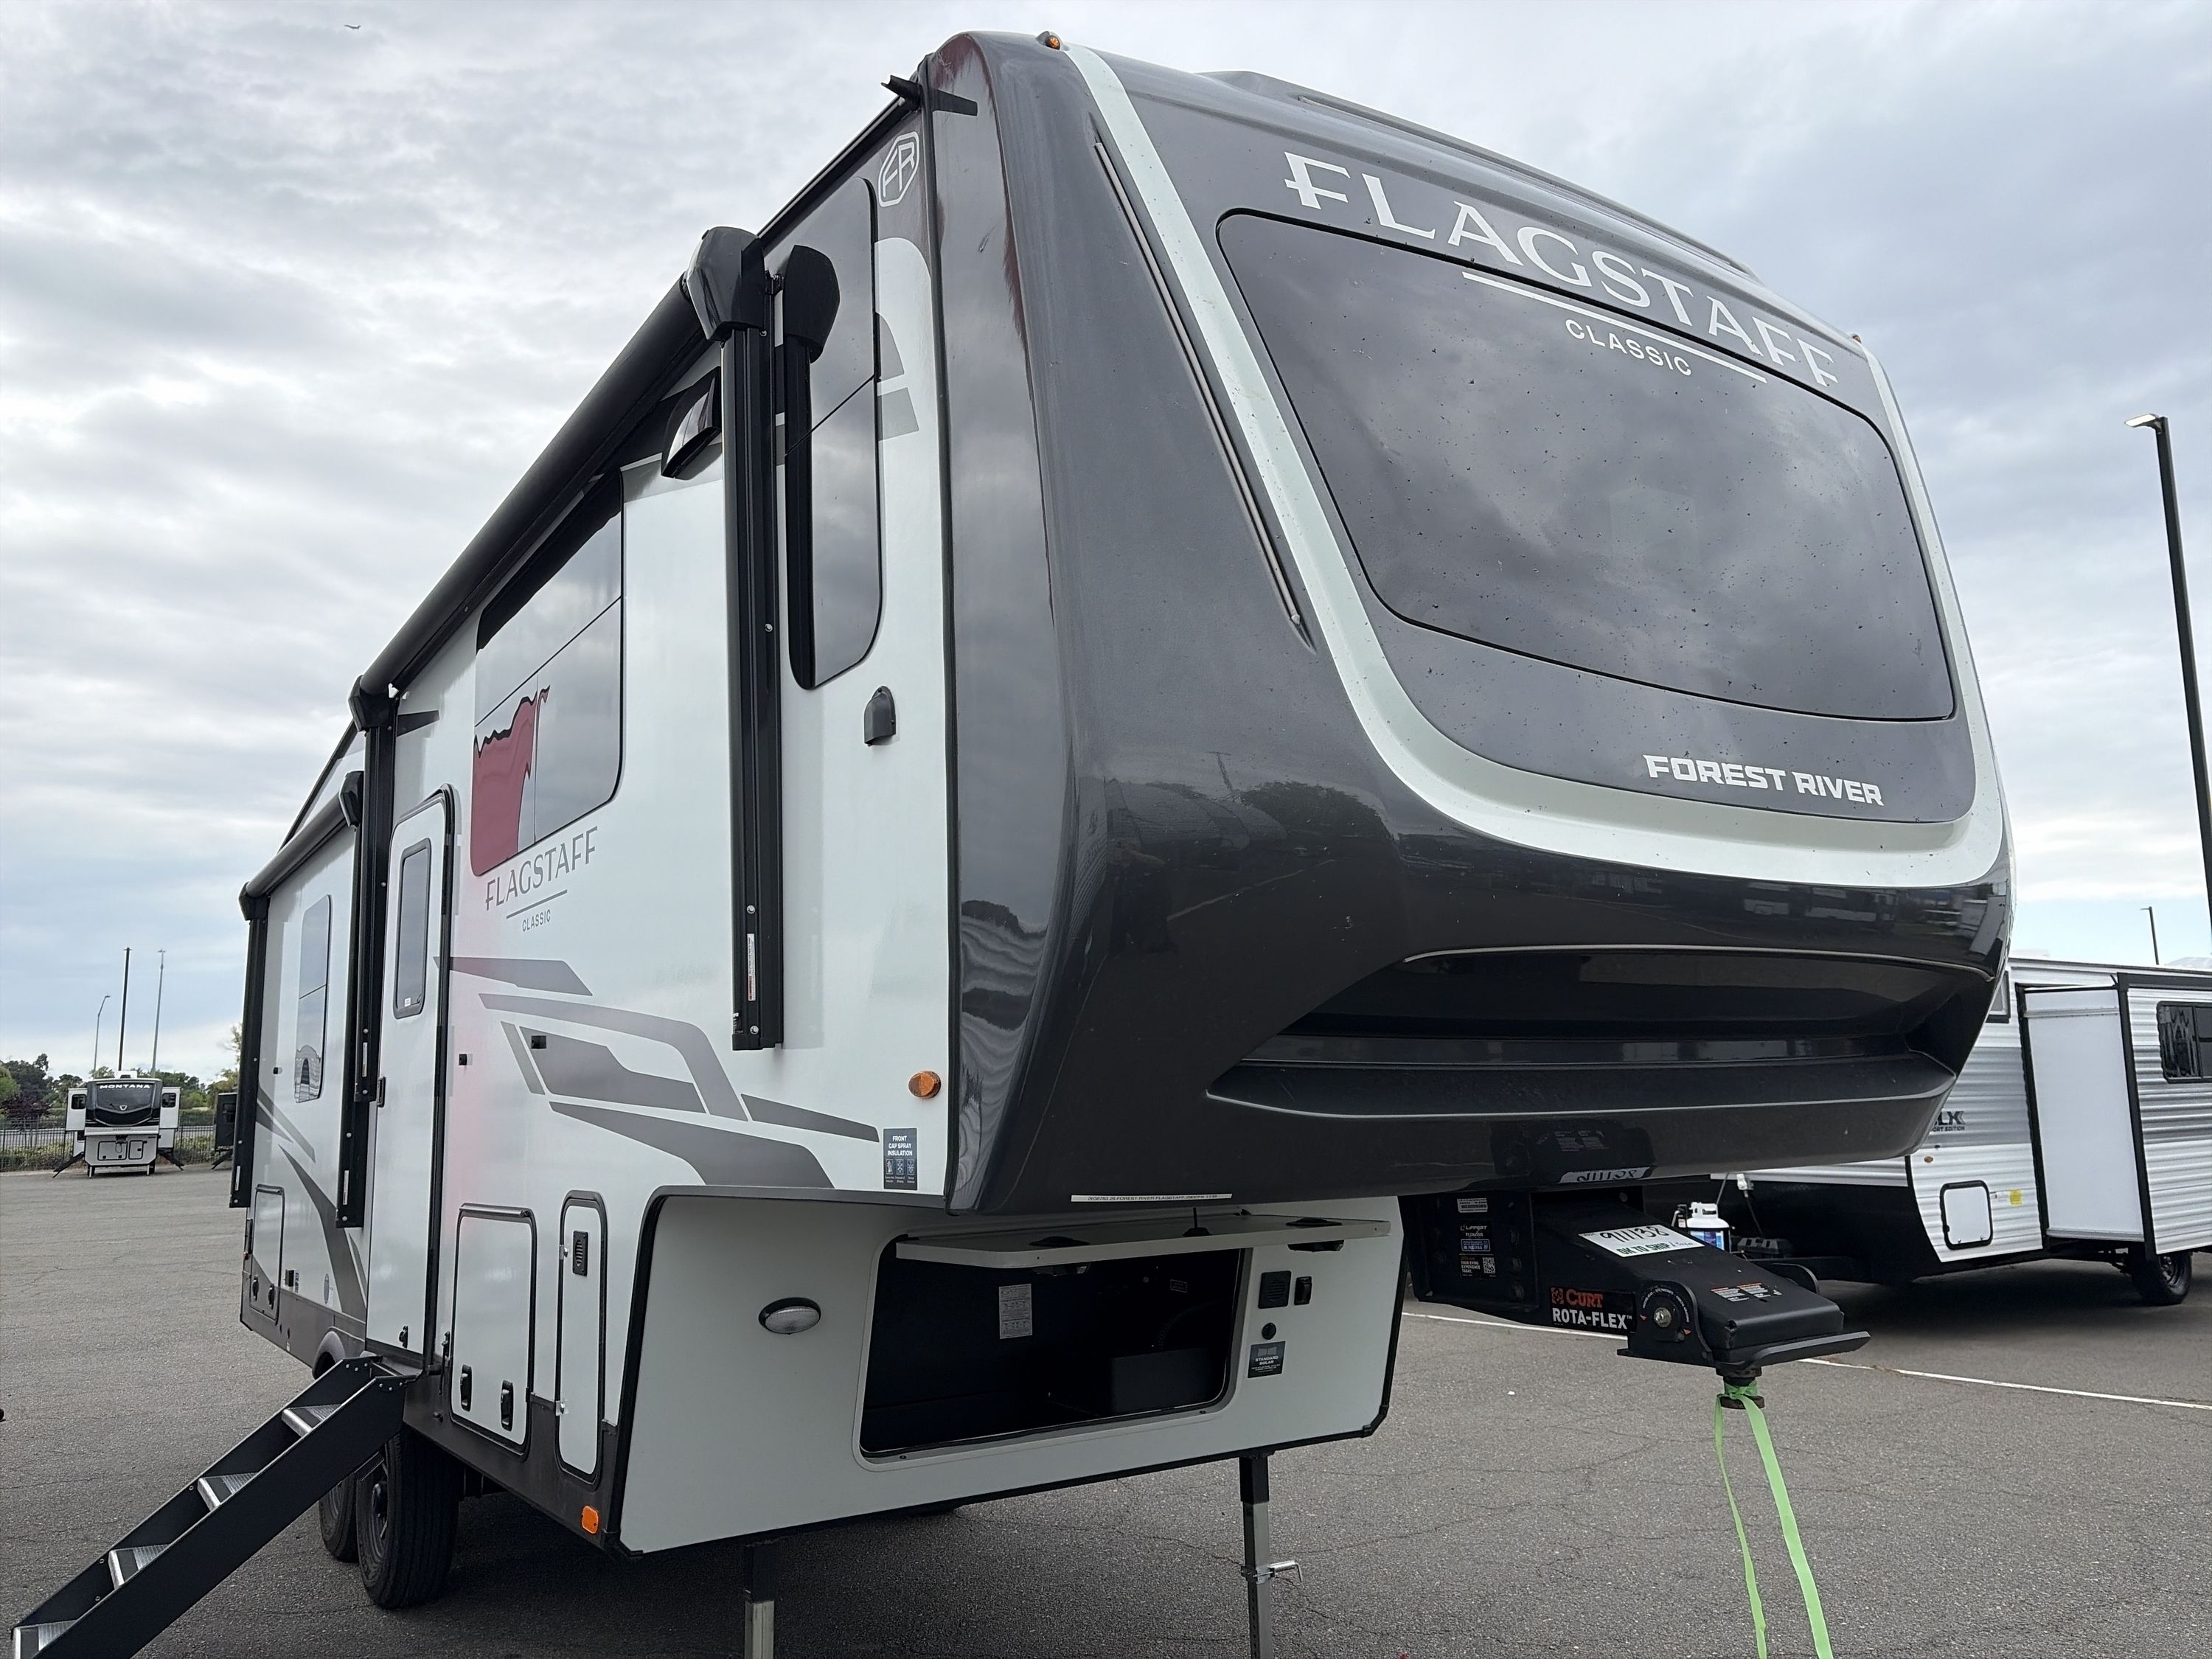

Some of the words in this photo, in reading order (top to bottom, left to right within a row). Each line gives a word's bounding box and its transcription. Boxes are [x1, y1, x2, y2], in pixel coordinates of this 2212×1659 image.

[1284, 151, 1838, 387] FLAGSTAFF
[1565, 319, 1692, 377] CLASSIC
[1643, 754, 1786, 791] FOREST
[1792, 771, 1885, 807] RIVER
[484, 826, 598, 911] FLAGSTAFF
[522, 908, 552, 932] CLASSIC
[1935, 1111, 1964, 1125] LX
[1599, 1226, 1669, 1243] 911138
[1616, 1246, 1634, 1255] OK
[1634, 1245, 1646, 1253] TO
[1646, 1242, 1670, 1252] SHIP
[1566, 1288, 1604, 1308] CURT
